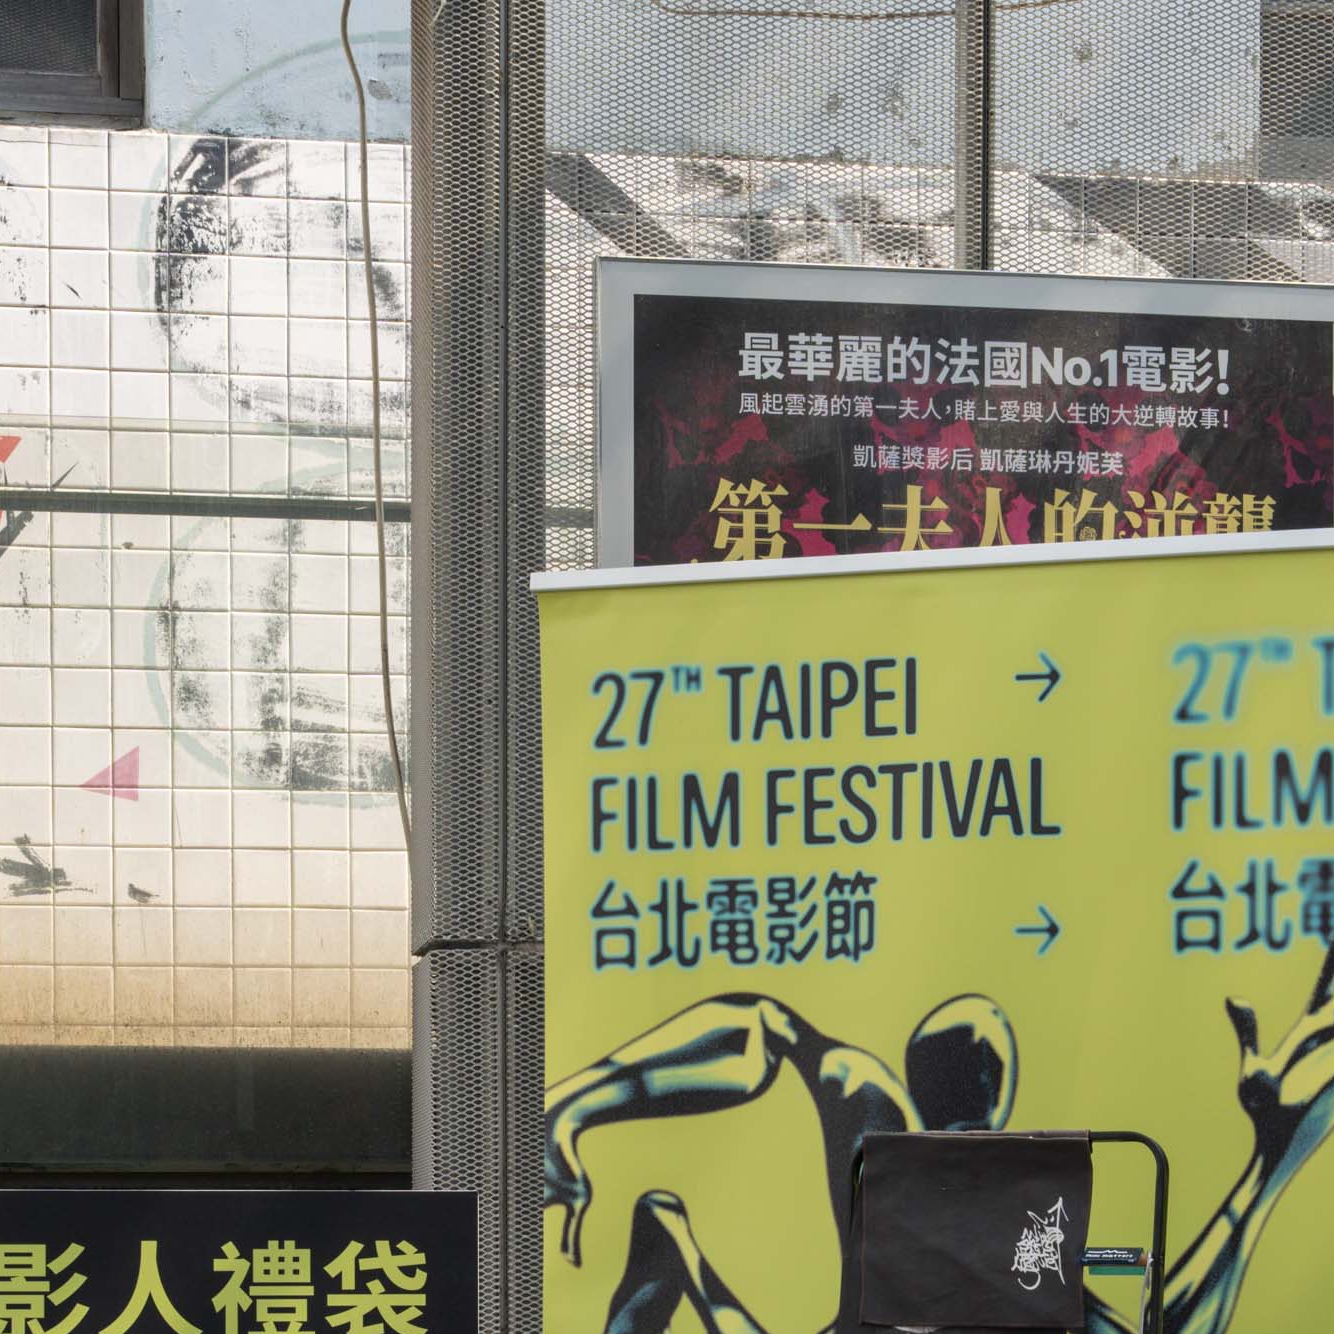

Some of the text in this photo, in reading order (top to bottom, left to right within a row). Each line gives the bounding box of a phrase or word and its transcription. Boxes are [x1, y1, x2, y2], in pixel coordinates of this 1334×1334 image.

[853, 443, 973, 474] 凱薩獎影后
[592, 656, 918, 749] 27TH TAIPEI
[591, 755, 1062, 854] FILM FESTIVAL
[590, 870, 878, 974] 台北電影節
